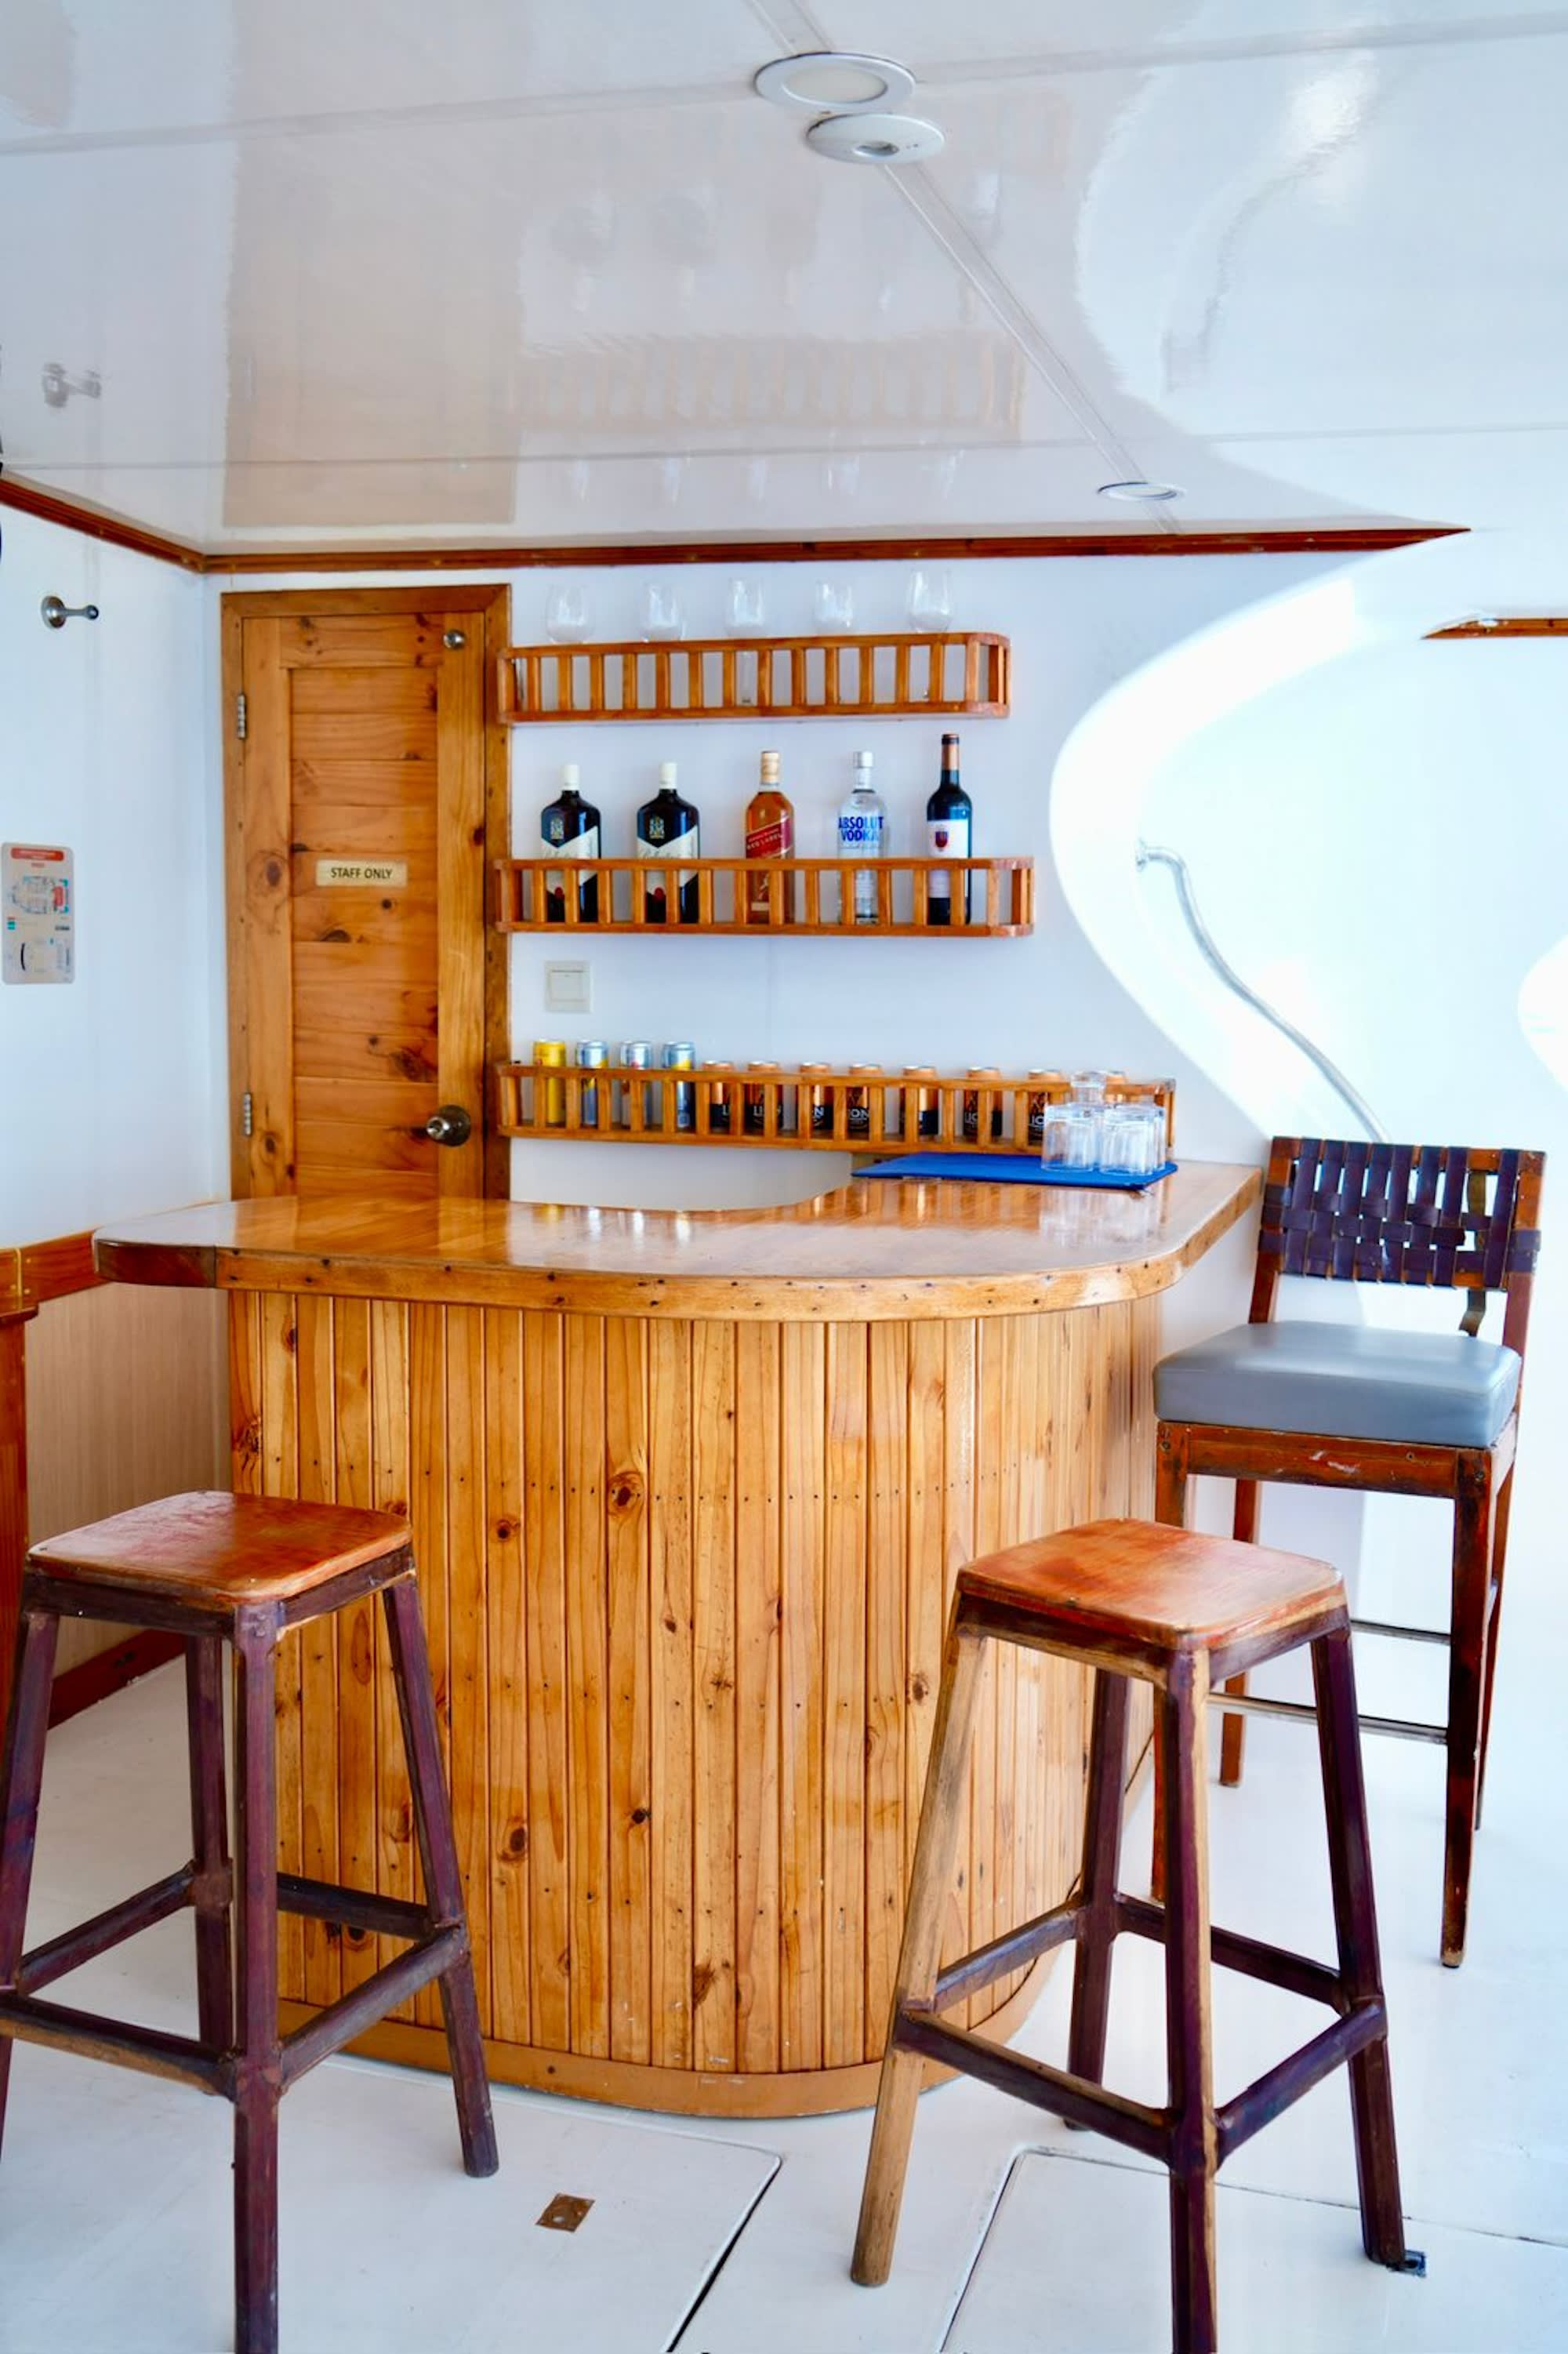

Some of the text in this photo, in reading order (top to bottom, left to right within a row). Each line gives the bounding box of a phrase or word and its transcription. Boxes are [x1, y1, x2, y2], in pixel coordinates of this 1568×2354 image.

[838, 816, 884, 829] ABSOLUT
[841, 830, 879, 841] VODKA
[331, 867, 393, 879] STAFF ONLY
